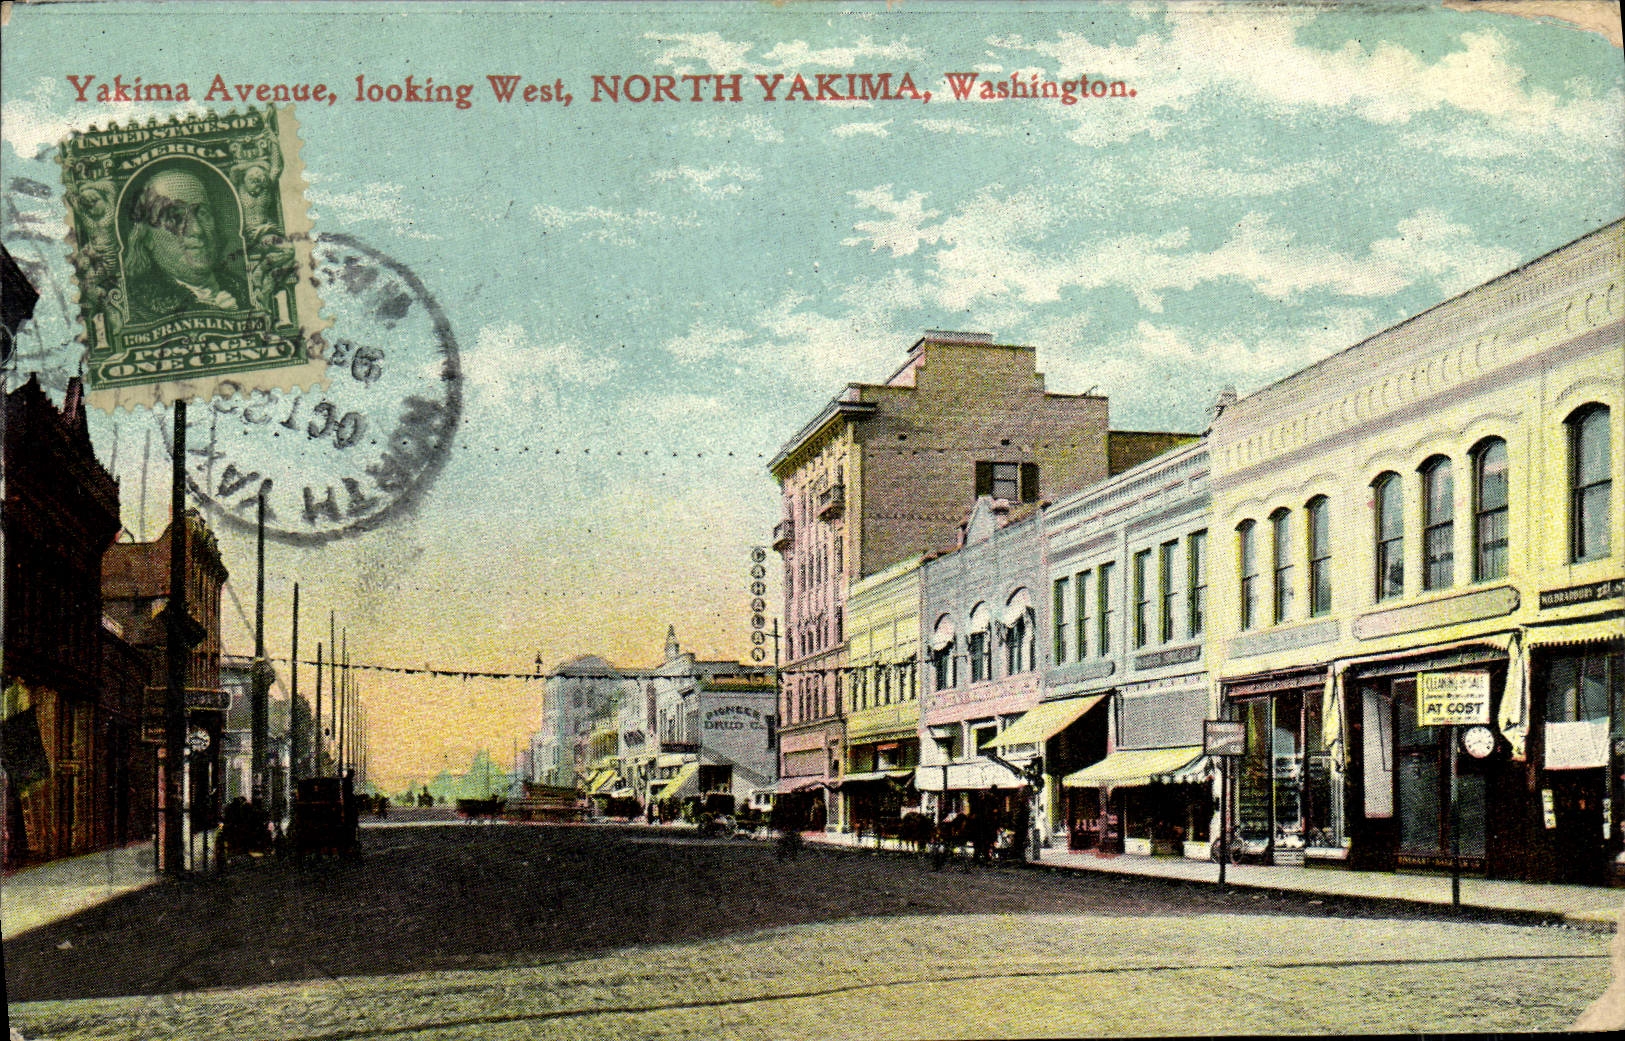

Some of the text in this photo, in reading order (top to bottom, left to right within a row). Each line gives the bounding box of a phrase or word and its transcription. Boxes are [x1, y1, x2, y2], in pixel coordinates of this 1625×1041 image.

[77, 116, 259, 150] UNITED STATES OF
[118, 143, 229, 171] AMERICA
[152, 317, 236, 340] FRANKLIN
[107, 344, 286, 377] ONE CENT
[133, 337, 257, 361] POSTAGE
[1425, 701, 1484, 715] AT COST
